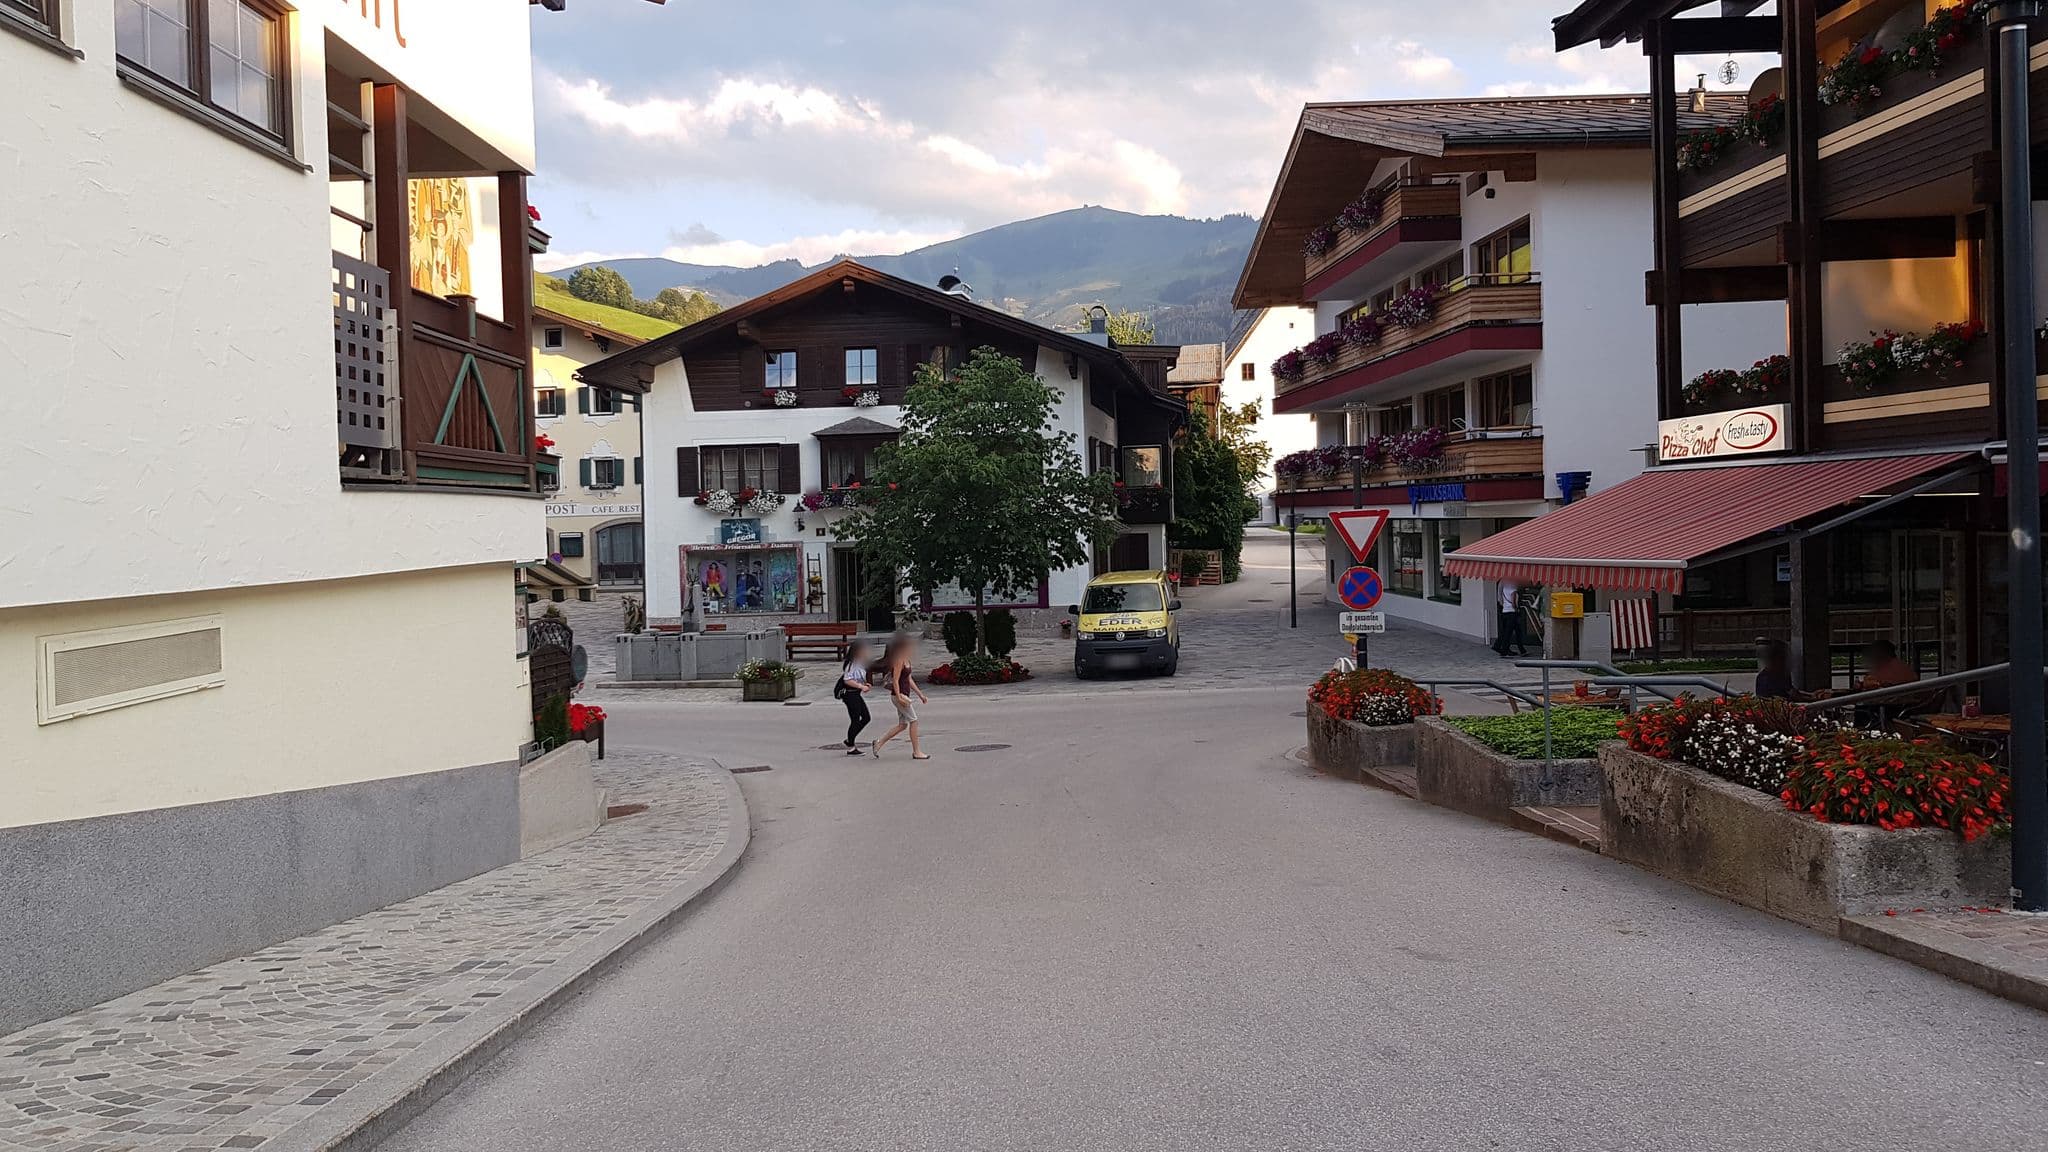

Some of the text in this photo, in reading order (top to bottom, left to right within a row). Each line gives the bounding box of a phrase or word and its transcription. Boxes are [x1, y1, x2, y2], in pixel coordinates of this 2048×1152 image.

[1661, 427, 1721, 458] Pizza Chef
[545, 504, 576, 515] POST
[726, 533, 756, 544] GREGOR
[1099, 618, 1142, 626] EDER
